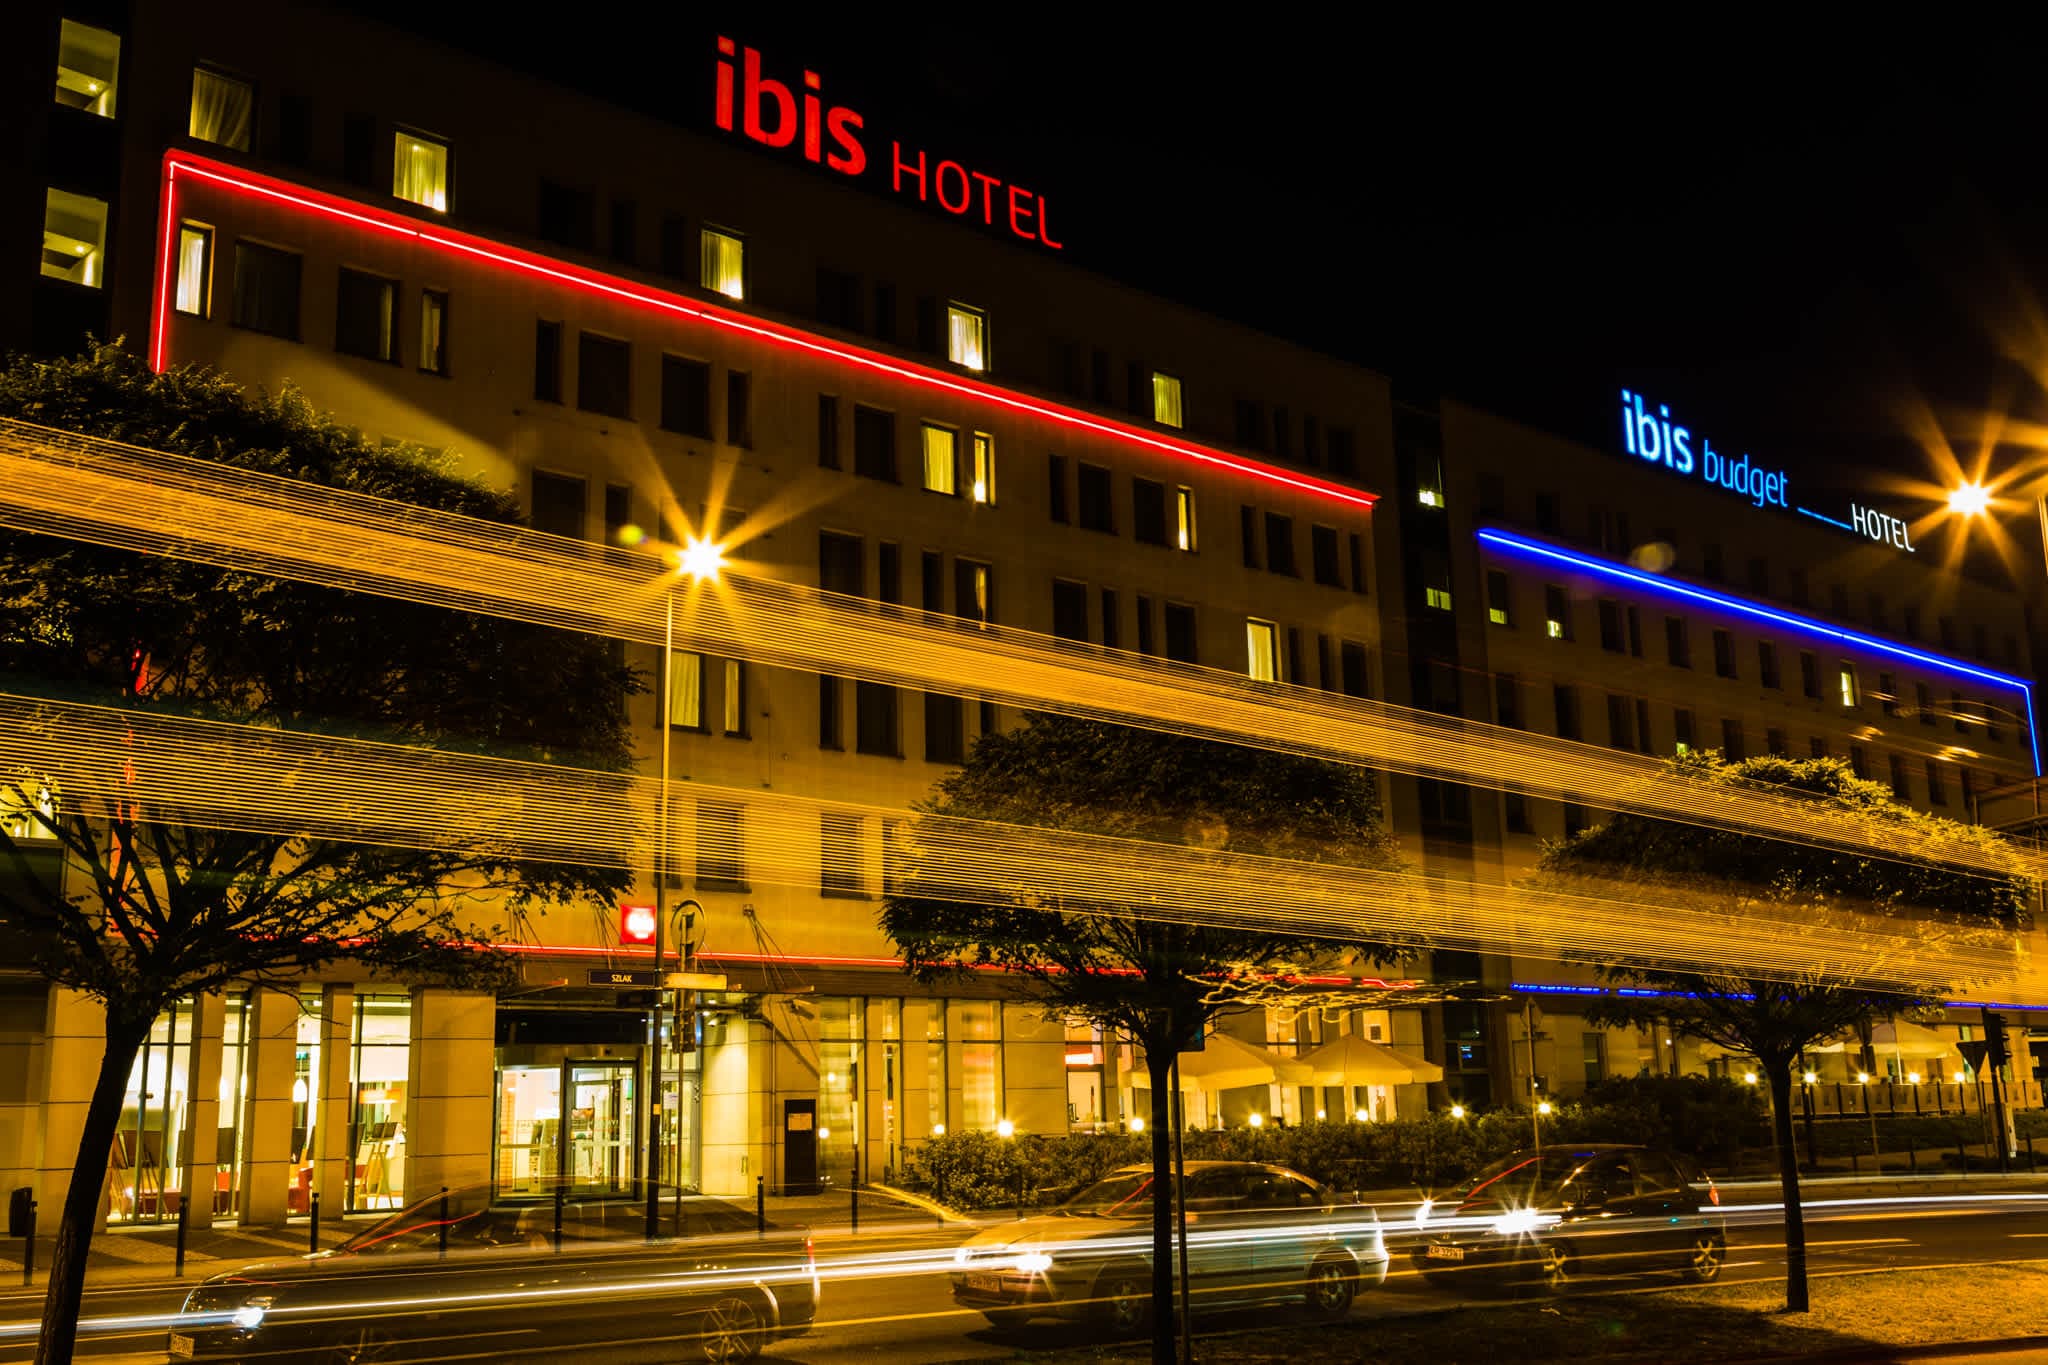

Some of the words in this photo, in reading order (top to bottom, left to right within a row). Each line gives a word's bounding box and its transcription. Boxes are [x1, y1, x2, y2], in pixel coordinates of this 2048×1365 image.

[716, 35, 867, 176] ibis
[892, 140, 1063, 249] HOTEL
[1621, 388, 1695, 474] ibis
[1703, 438, 1789, 508] budget
[1851, 502, 1916, 552] HOTEL
[611, 974, 633, 983] SZLAK
